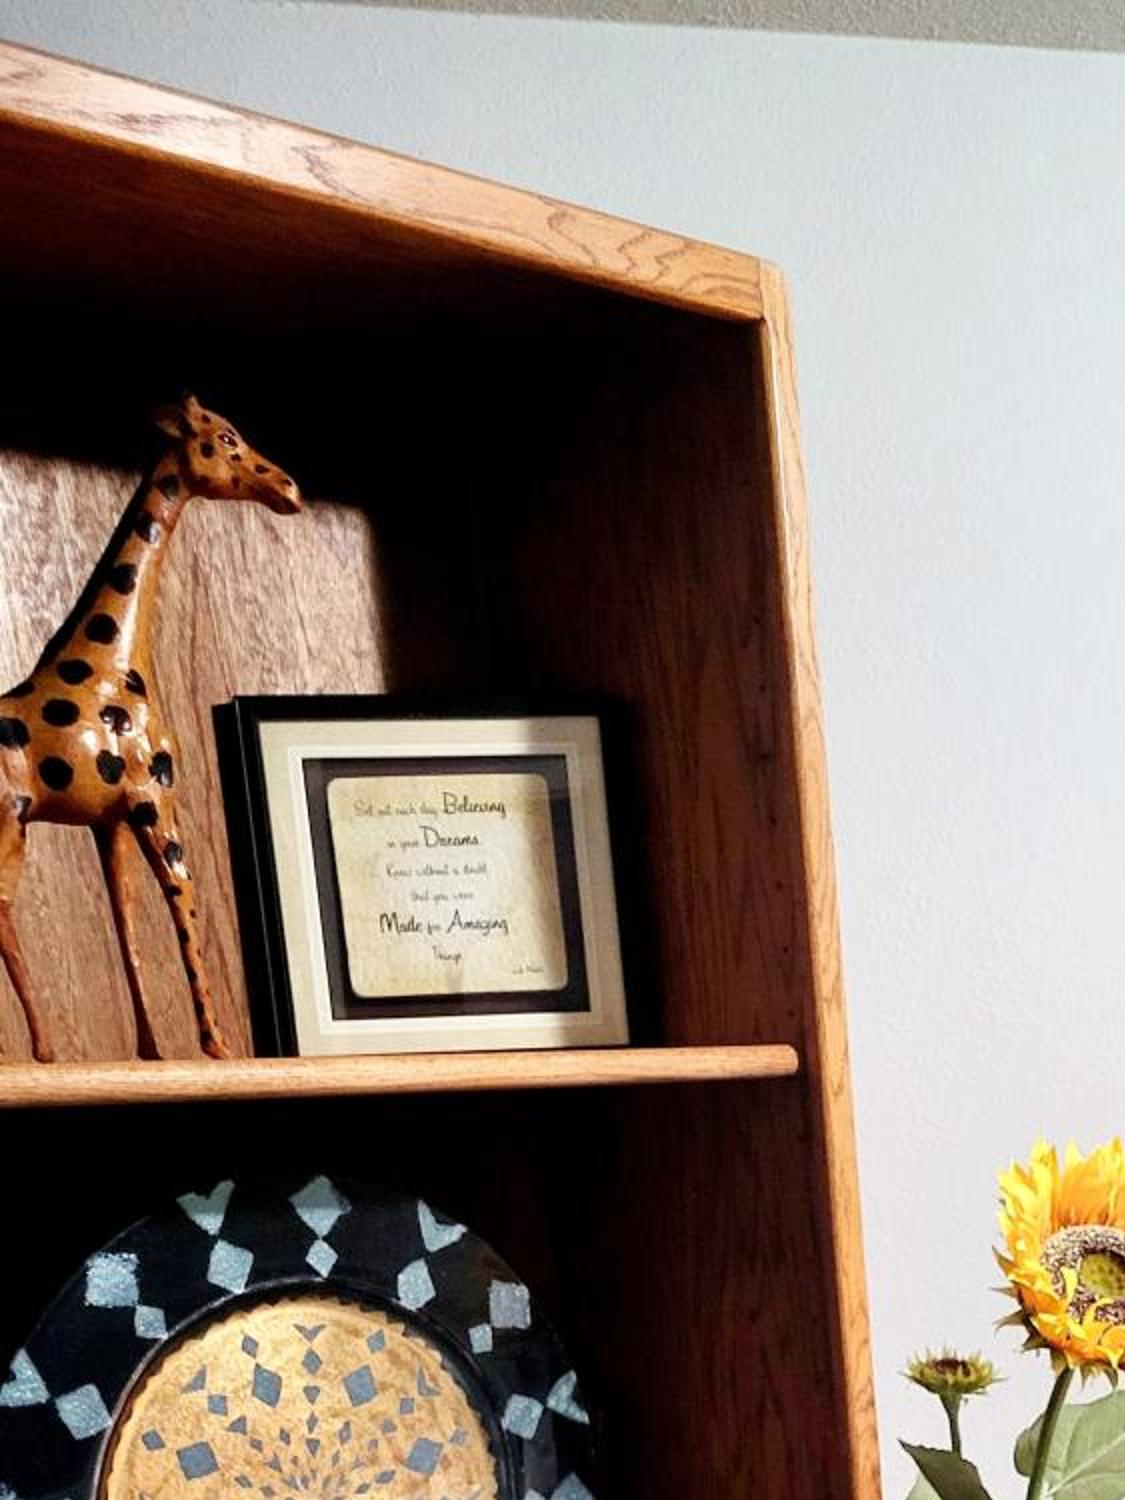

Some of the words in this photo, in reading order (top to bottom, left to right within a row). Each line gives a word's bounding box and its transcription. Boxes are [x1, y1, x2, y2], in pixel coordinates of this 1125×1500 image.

[442, 791, 507, 819] Believing
[419, 825, 480, 848] Dreams
[380, 911, 423, 936] Made
[446, 908, 509, 937] Amazing
